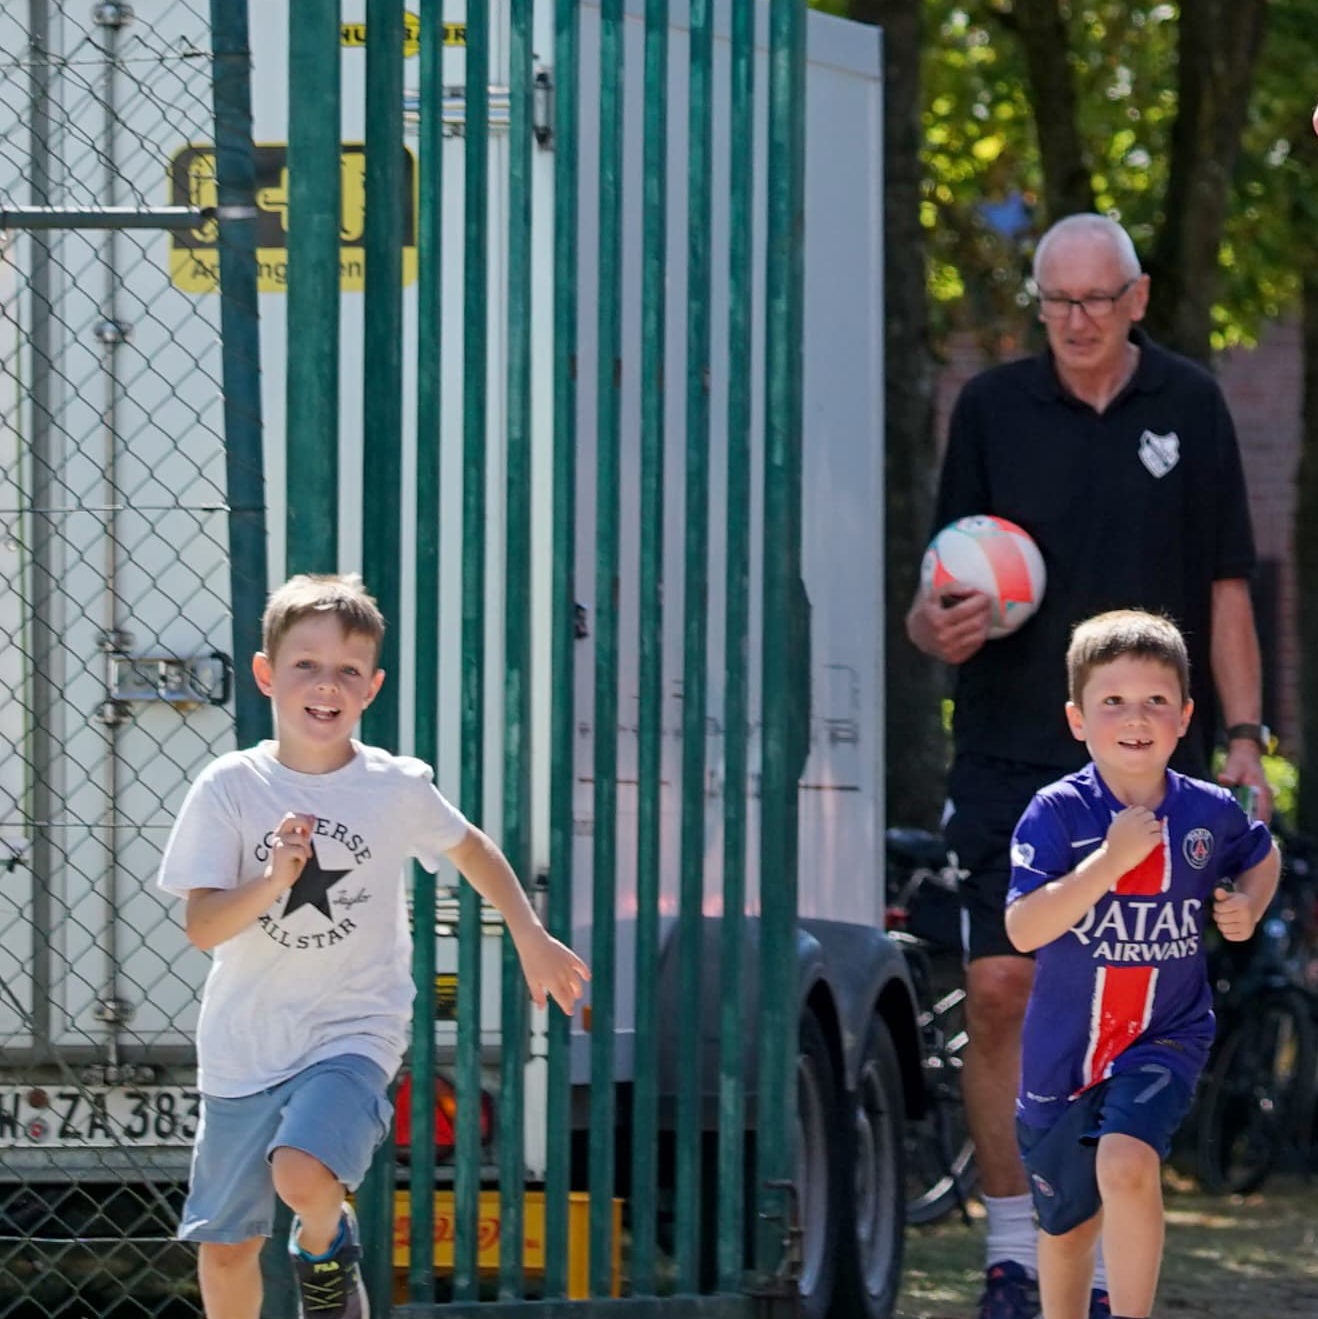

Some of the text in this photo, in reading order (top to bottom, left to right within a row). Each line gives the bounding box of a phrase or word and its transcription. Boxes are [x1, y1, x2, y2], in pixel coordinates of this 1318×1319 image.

[258, 913, 292, 949] ALL
[295, 917, 358, 950] STAR
[1092, 934, 1199, 962] AIRWAYS
